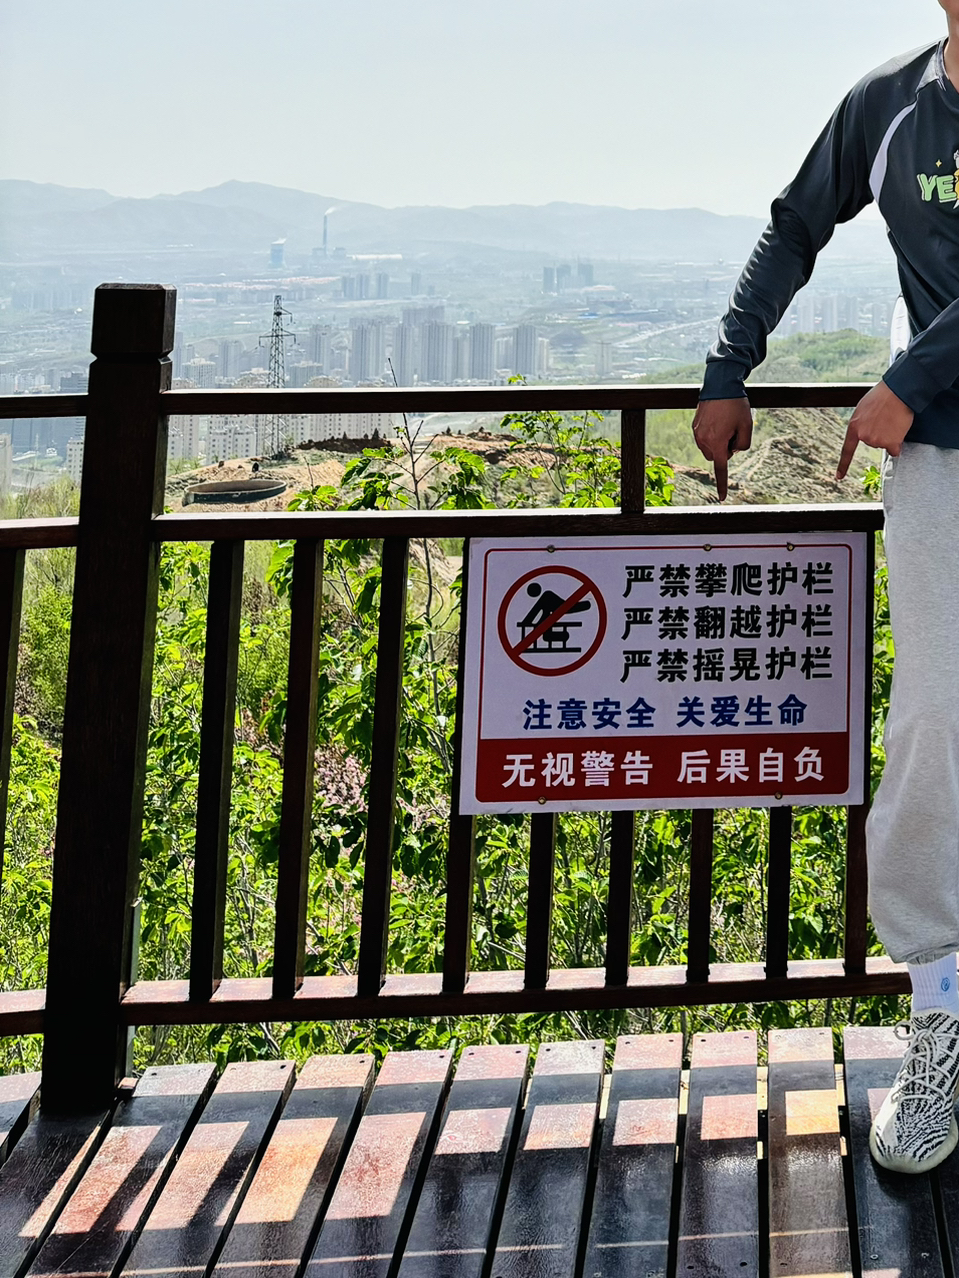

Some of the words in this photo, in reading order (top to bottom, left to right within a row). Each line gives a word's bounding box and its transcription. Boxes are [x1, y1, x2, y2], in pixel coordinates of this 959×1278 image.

[622, 561, 834, 598] 严禁攀爬护栏
[621, 604, 833, 641] 严禁翻越护栏
[620, 646, 833, 683] 严禁摇晃护栏
[522, 697, 656, 731] 注意安全
[676, 693, 808, 728] 关爱生命
[502, 750, 654, 788] 无视警告
[677, 746, 825, 784] 后果自负
